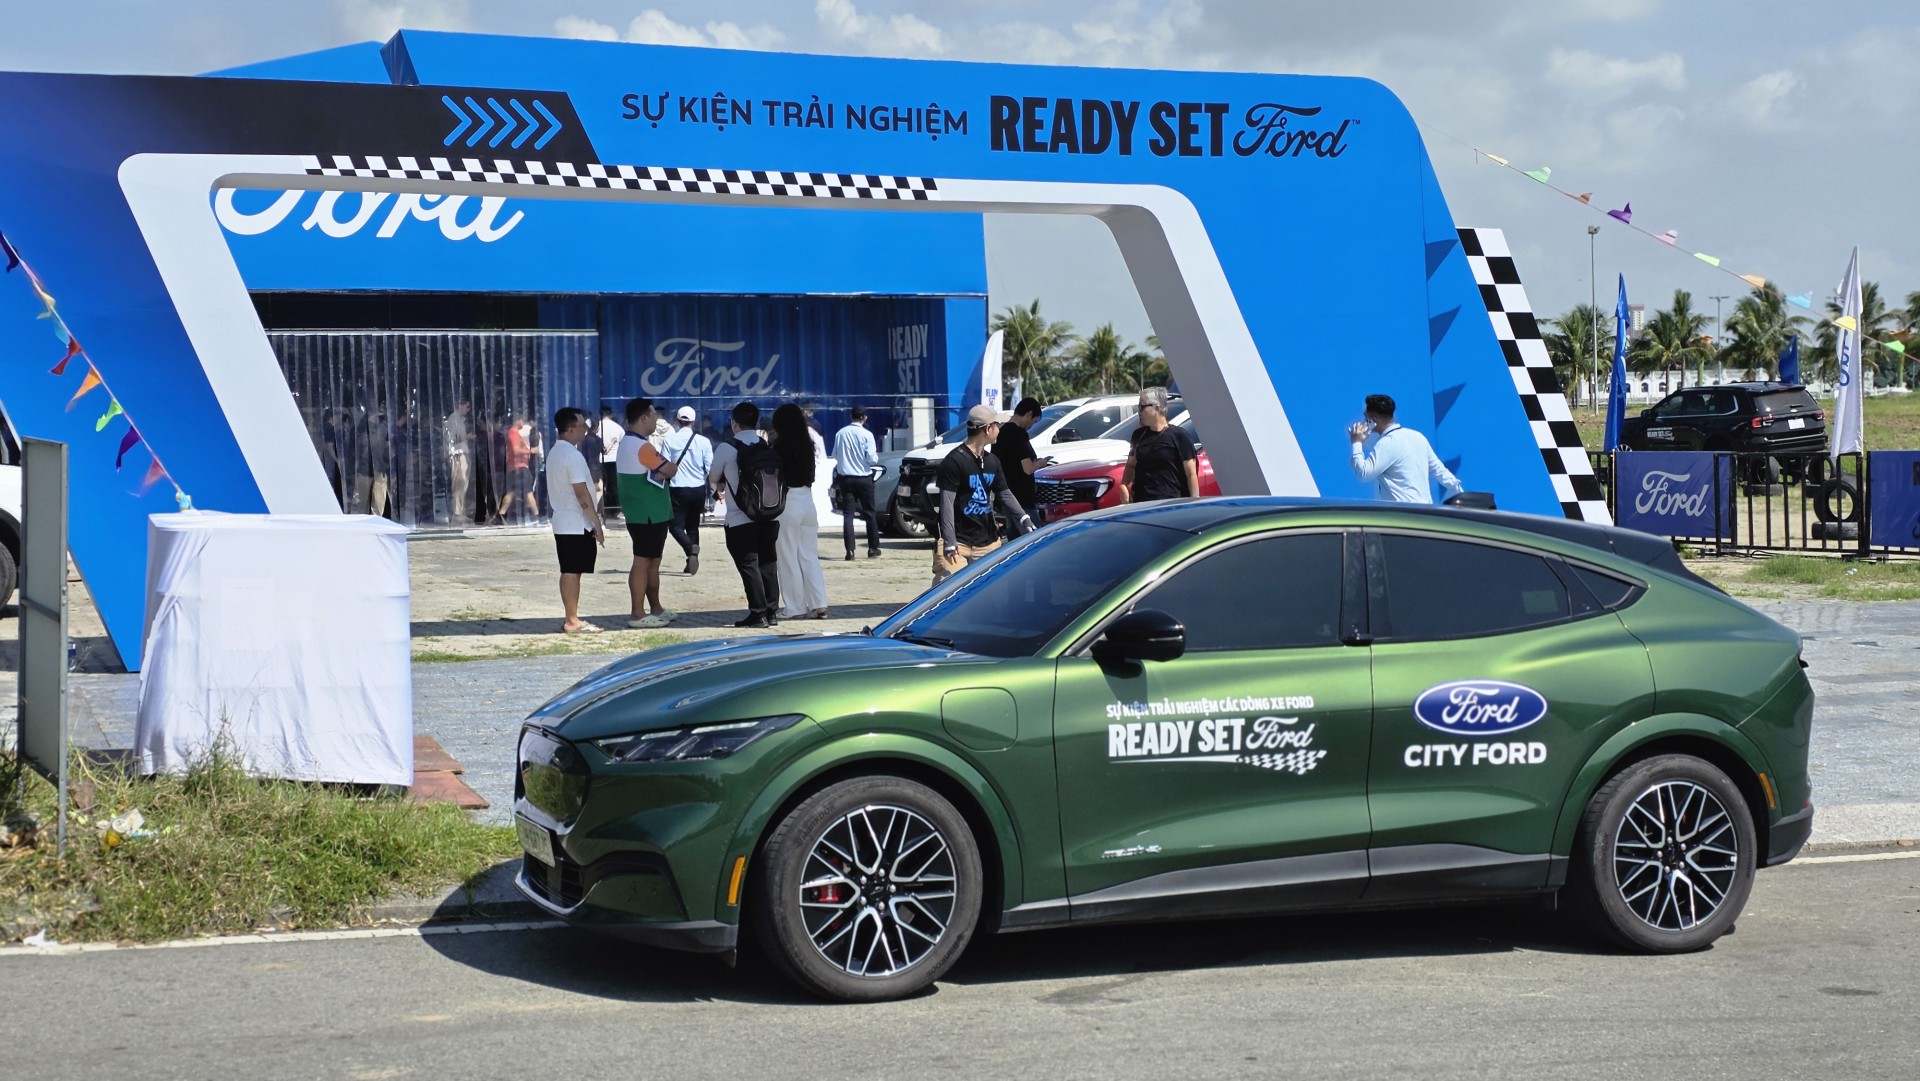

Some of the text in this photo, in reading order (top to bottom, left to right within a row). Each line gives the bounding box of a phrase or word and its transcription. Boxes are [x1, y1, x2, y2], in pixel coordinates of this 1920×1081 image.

[621, 91, 670, 129] SỰ
[678, 91, 752, 132] KIỆN
[762, 95, 834, 129] TRẢI
[846, 102, 968, 142] NGHIỆM
[990, 95, 1140, 156] READY
[1149, 102, 1229, 157] SET
[1233, 103, 1350, 158] Ford
[640, 337, 780, 395] Ford
[898, 359, 920, 393] SET
[1635, 470, 1709, 517] Ford
[1149, 697, 1176, 715] TRẢI
[1176, 697, 1219, 716] NGHIỆM
[1220, 696, 1240, 712] CÁC
[1240, 695, 1270, 711] DÒNG
[1270, 697, 1285, 710] XE
[1285, 695, 1314, 709] FORD
[1441, 686, 1520, 724] Ford
[1108, 716, 1316, 757] READY SET Ford
[1404, 742, 1547, 767] CITY FORD
